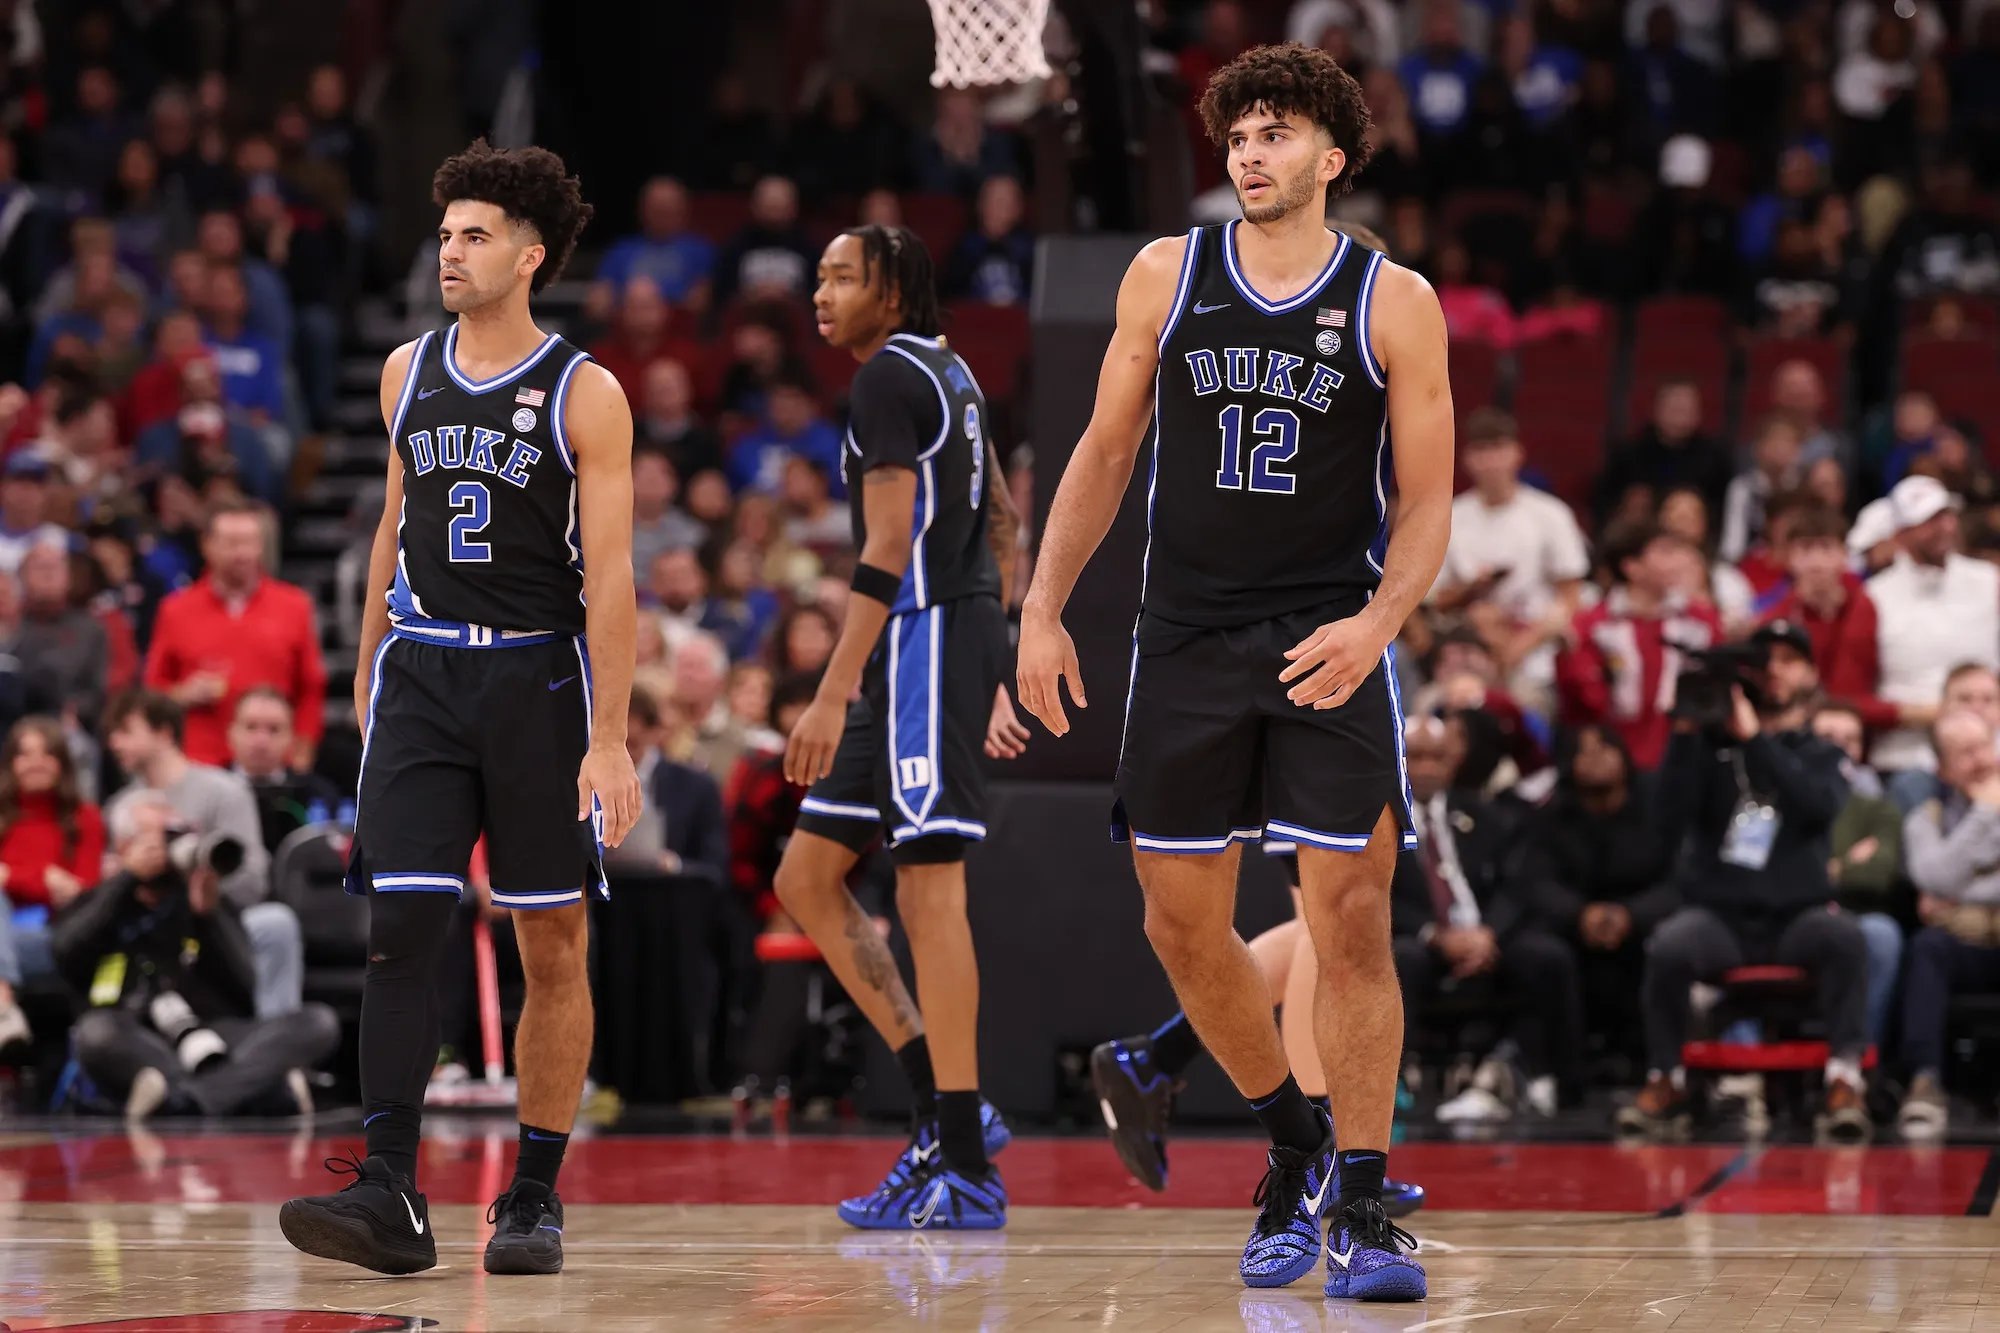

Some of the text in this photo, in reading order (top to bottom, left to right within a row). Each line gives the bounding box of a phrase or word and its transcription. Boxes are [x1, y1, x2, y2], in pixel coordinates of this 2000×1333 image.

[1185, 348, 1345, 413] DUKE
[408, 425, 542, 489] DUKE
[963, 402, 984, 510] 3
[1216, 403, 1300, 494] 12
[448, 481, 492, 563] 2
[467, 622, 493, 646] D
[899, 756, 931, 790] D
